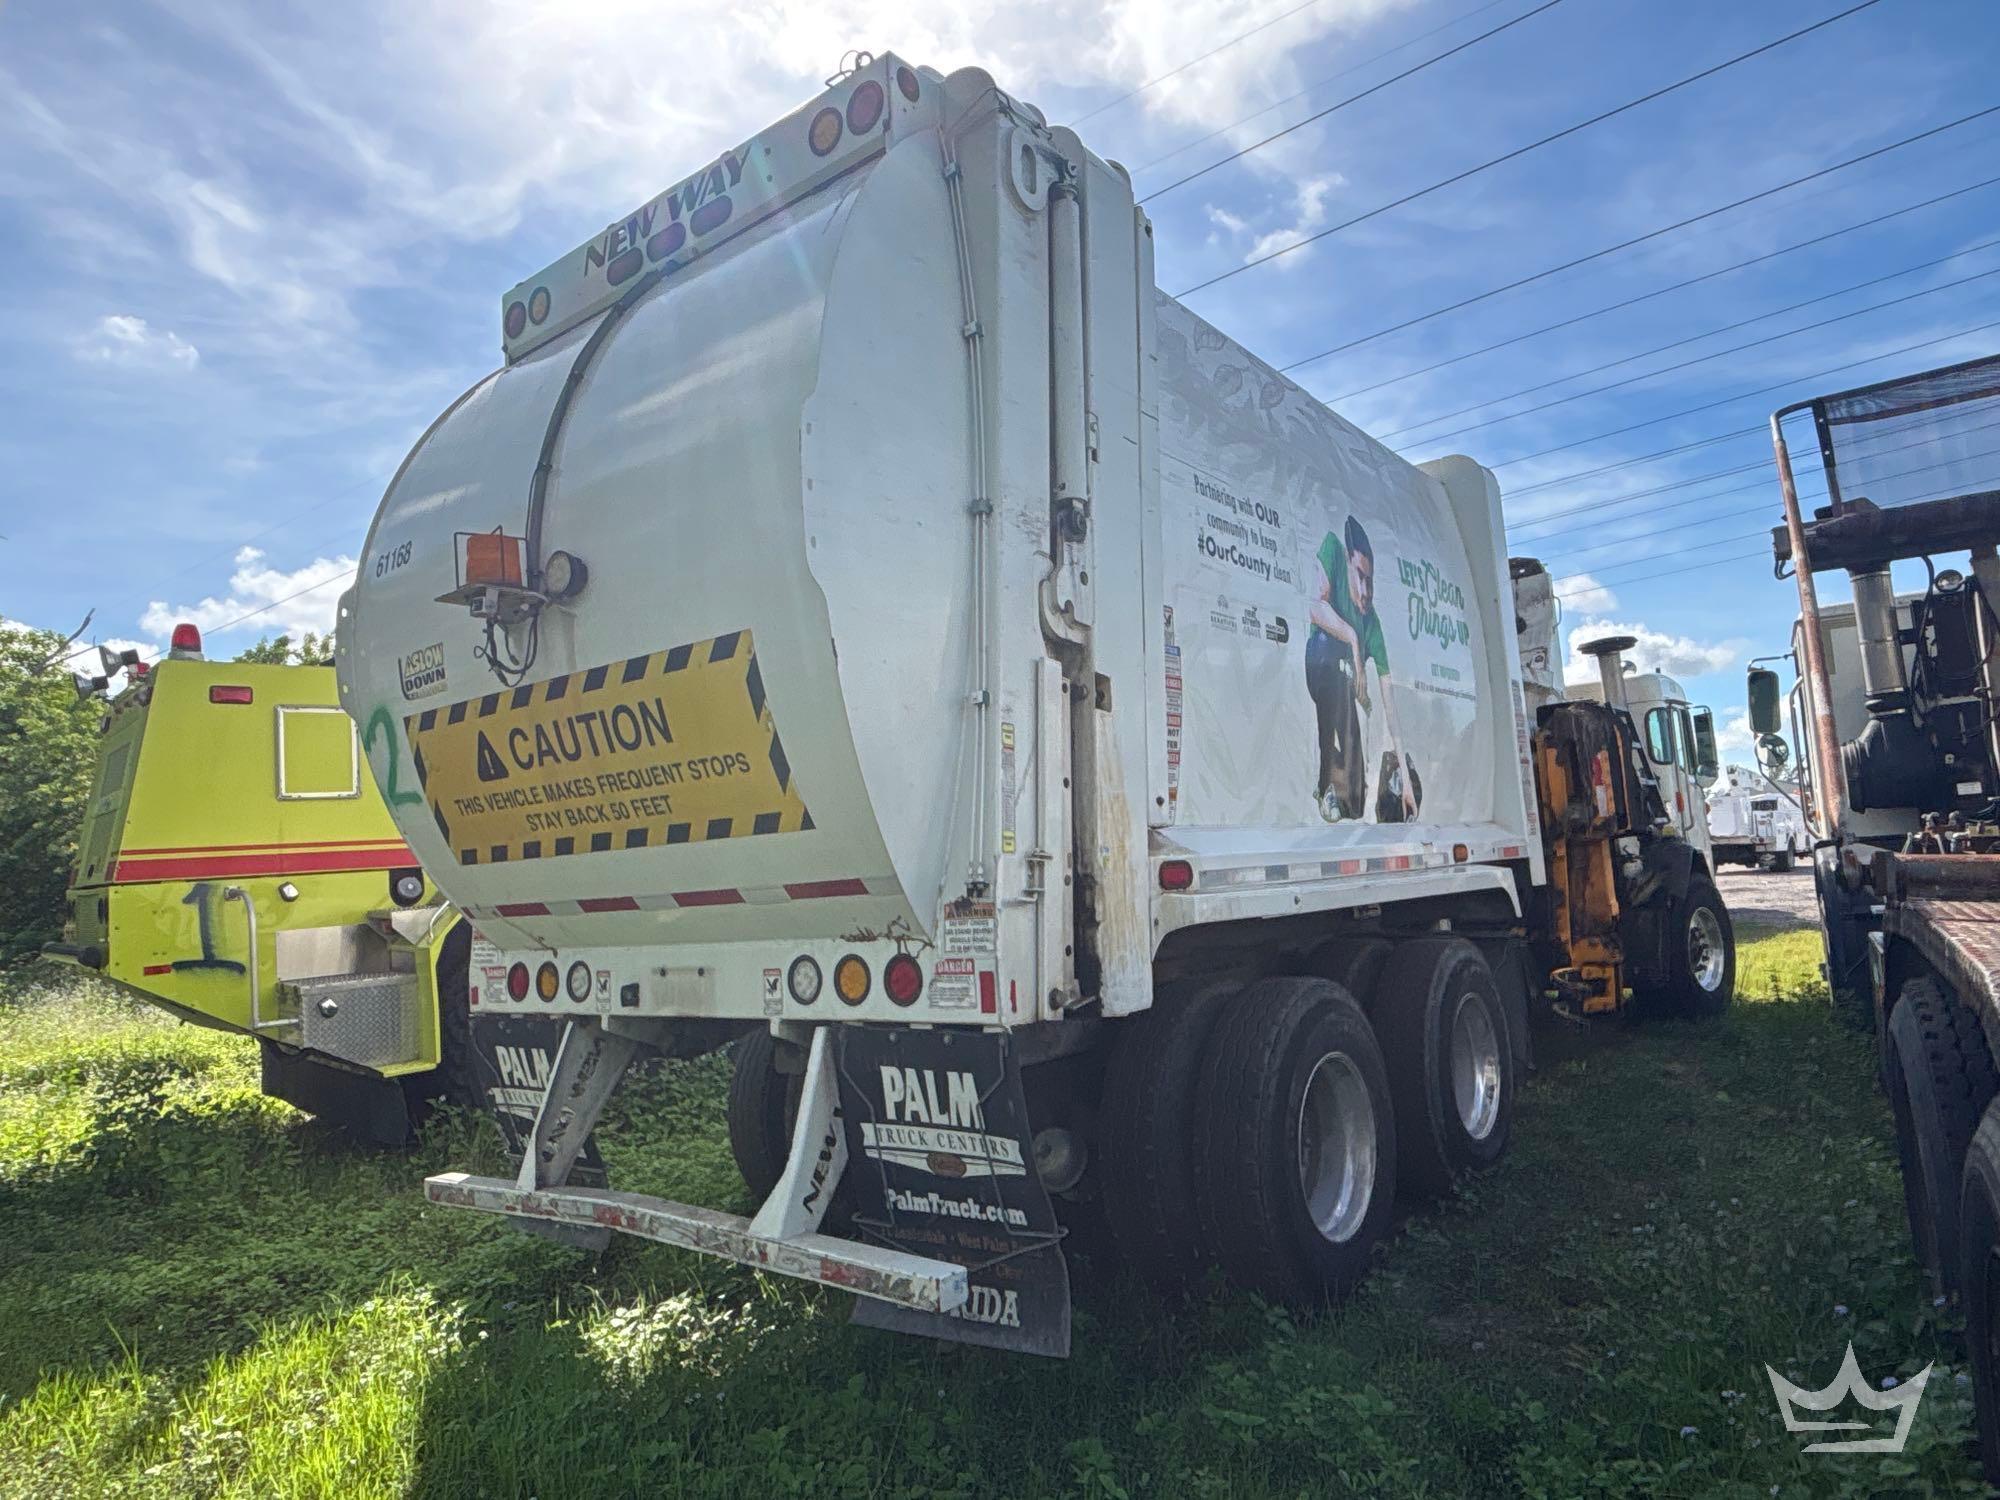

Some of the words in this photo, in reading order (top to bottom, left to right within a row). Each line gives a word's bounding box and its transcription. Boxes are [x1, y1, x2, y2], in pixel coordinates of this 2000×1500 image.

[584, 203, 657, 277] NEW
[667, 143, 751, 221] WAY
[1193, 473, 1237, 514] Partnering
[1237, 497, 1254, 517] with
[1255, 502, 1281, 529] OUR
[376, 540, 413, 578] 61168
[1198, 527, 1271, 581] #OurCounty
[1273, 560, 1292, 584] clean
[1207, 513, 1249, 546] community
[1250, 528, 1259, 545] to
[1259, 527, 1278, 557] keep
[1397, 557, 1426, 593] LET'S
[1421, 558, 1465, 611] Clean
[1408, 592, 1457, 650] Things
[1456, 619, 1470, 647] UP
[405, 667, 446, 692] DOWN
[410, 642, 444, 673] SLOW
[364, 704, 422, 807] 2
[508, 697, 674, 771] CAUTION
[454, 797, 485, 817] THIS
[486, 785, 547, 811] VEHICLE
[542, 777, 596, 803] MAKES
[597, 762, 685, 795] FREQUENT
[688, 752, 751, 781] STOPS
[526, 812, 563, 832] STAY
[565, 803, 608, 826] BACK
[611, 800, 630, 820] 50
[633, 795, 673, 818] FEET
[937, 960, 974, 973] DANGER
[880, 1065, 985, 1130] PALM
[876, 1126, 929, 1146] TRUCK
[886, 1188, 1028, 1226] PalmTruck.com
